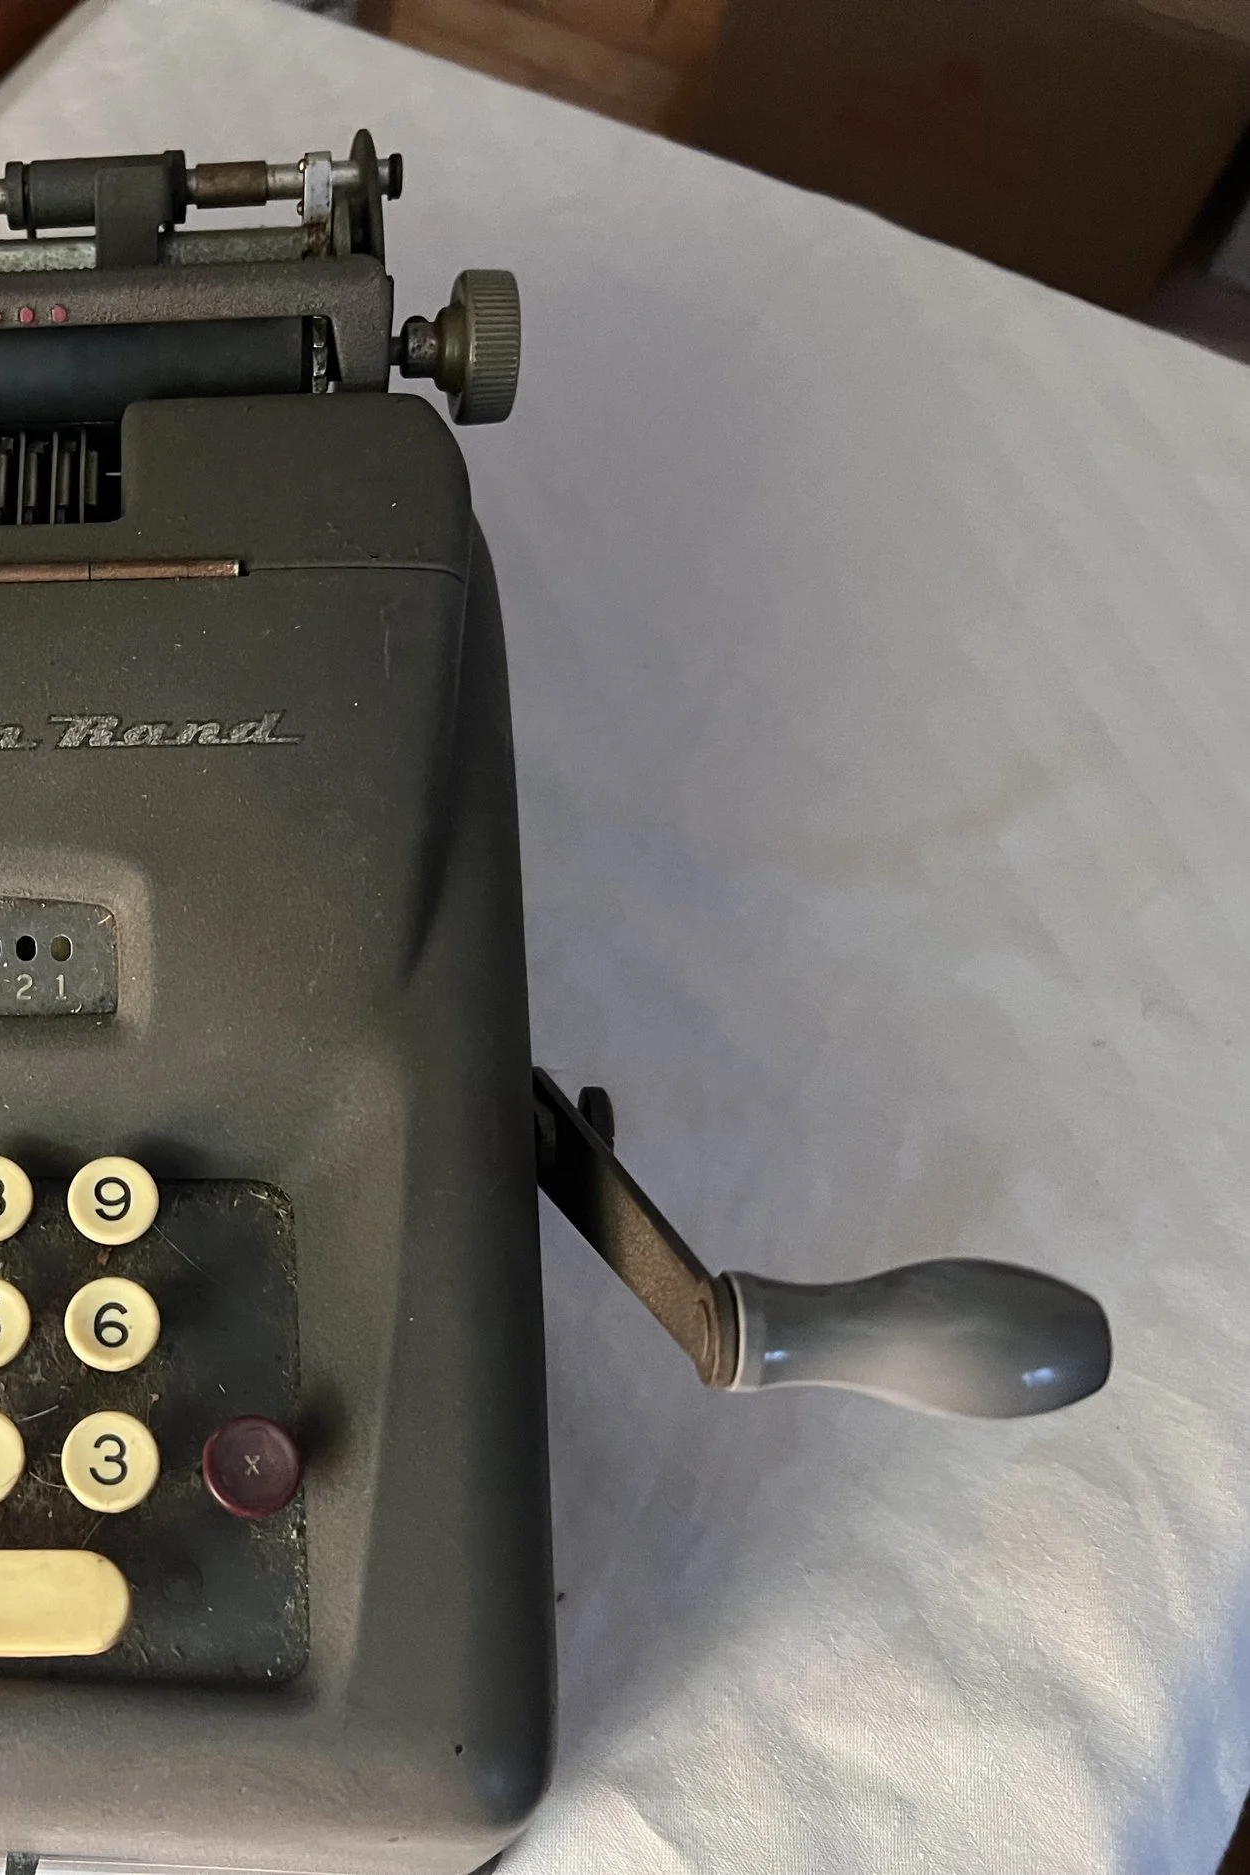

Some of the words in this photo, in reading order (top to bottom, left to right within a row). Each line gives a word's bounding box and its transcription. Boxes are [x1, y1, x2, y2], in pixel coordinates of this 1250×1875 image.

[49, 709, 302, 748] Rand
[16, 973, 33, 1001] 2
[55, 973, 67, 1001] 1
[93, 1176, 131, 1221] 9
[93, 1302, 129, 1348] 6
[89, 1434, 128, 1485] 3
